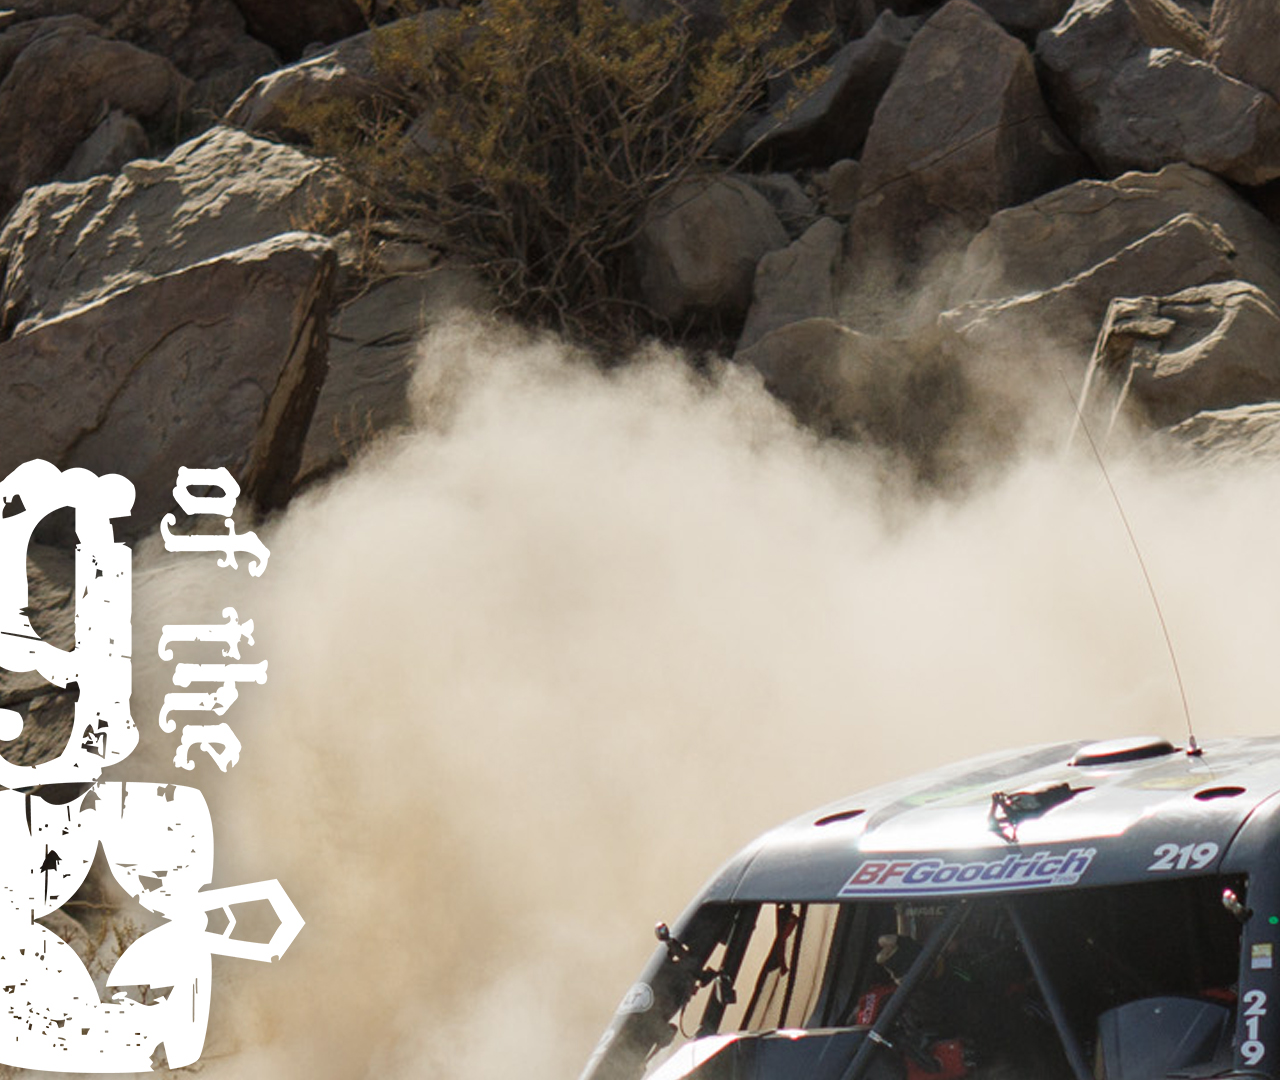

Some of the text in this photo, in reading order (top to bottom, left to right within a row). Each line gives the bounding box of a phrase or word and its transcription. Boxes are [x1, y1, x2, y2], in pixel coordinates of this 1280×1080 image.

[849, 851, 1089, 886] BFGoodrich
[1146, 843, 1219, 871] 219
[1240, 989, 1267, 1065] 219
